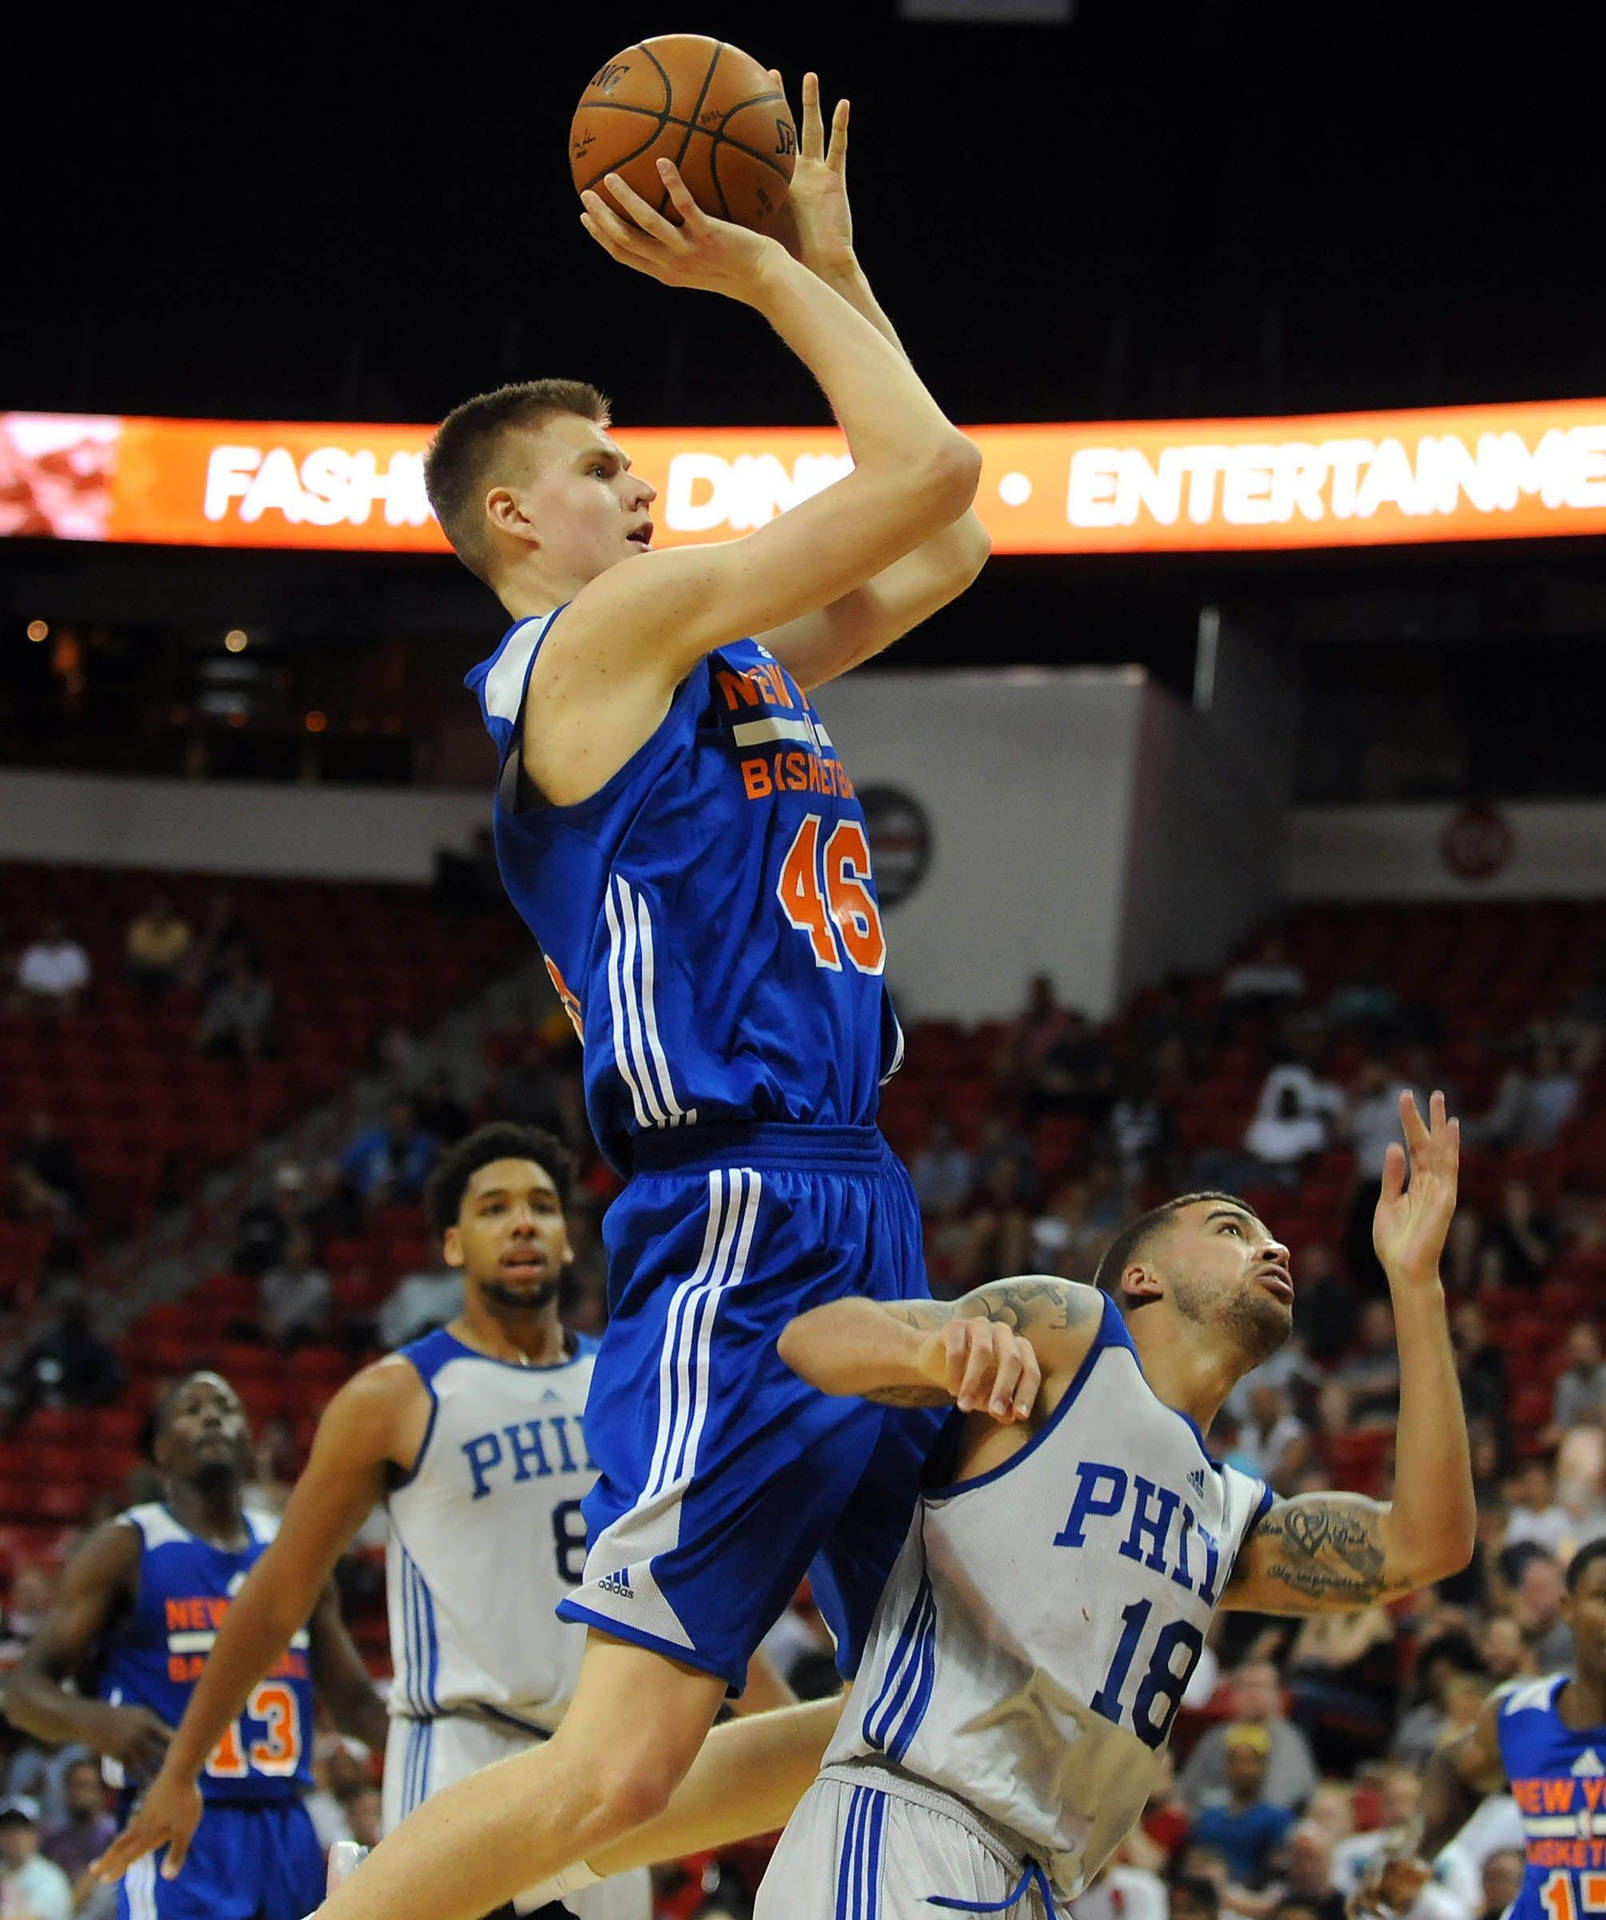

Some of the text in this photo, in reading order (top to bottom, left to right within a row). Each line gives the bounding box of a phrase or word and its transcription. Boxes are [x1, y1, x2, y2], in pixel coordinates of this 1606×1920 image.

[204, 444, 440, 526] FASHI
[776, 813, 887, 976] 46
[598, 1580, 635, 1600] adidas
[1089, 1597, 1204, 1751] 18
[205, 1681, 302, 1778] 13
